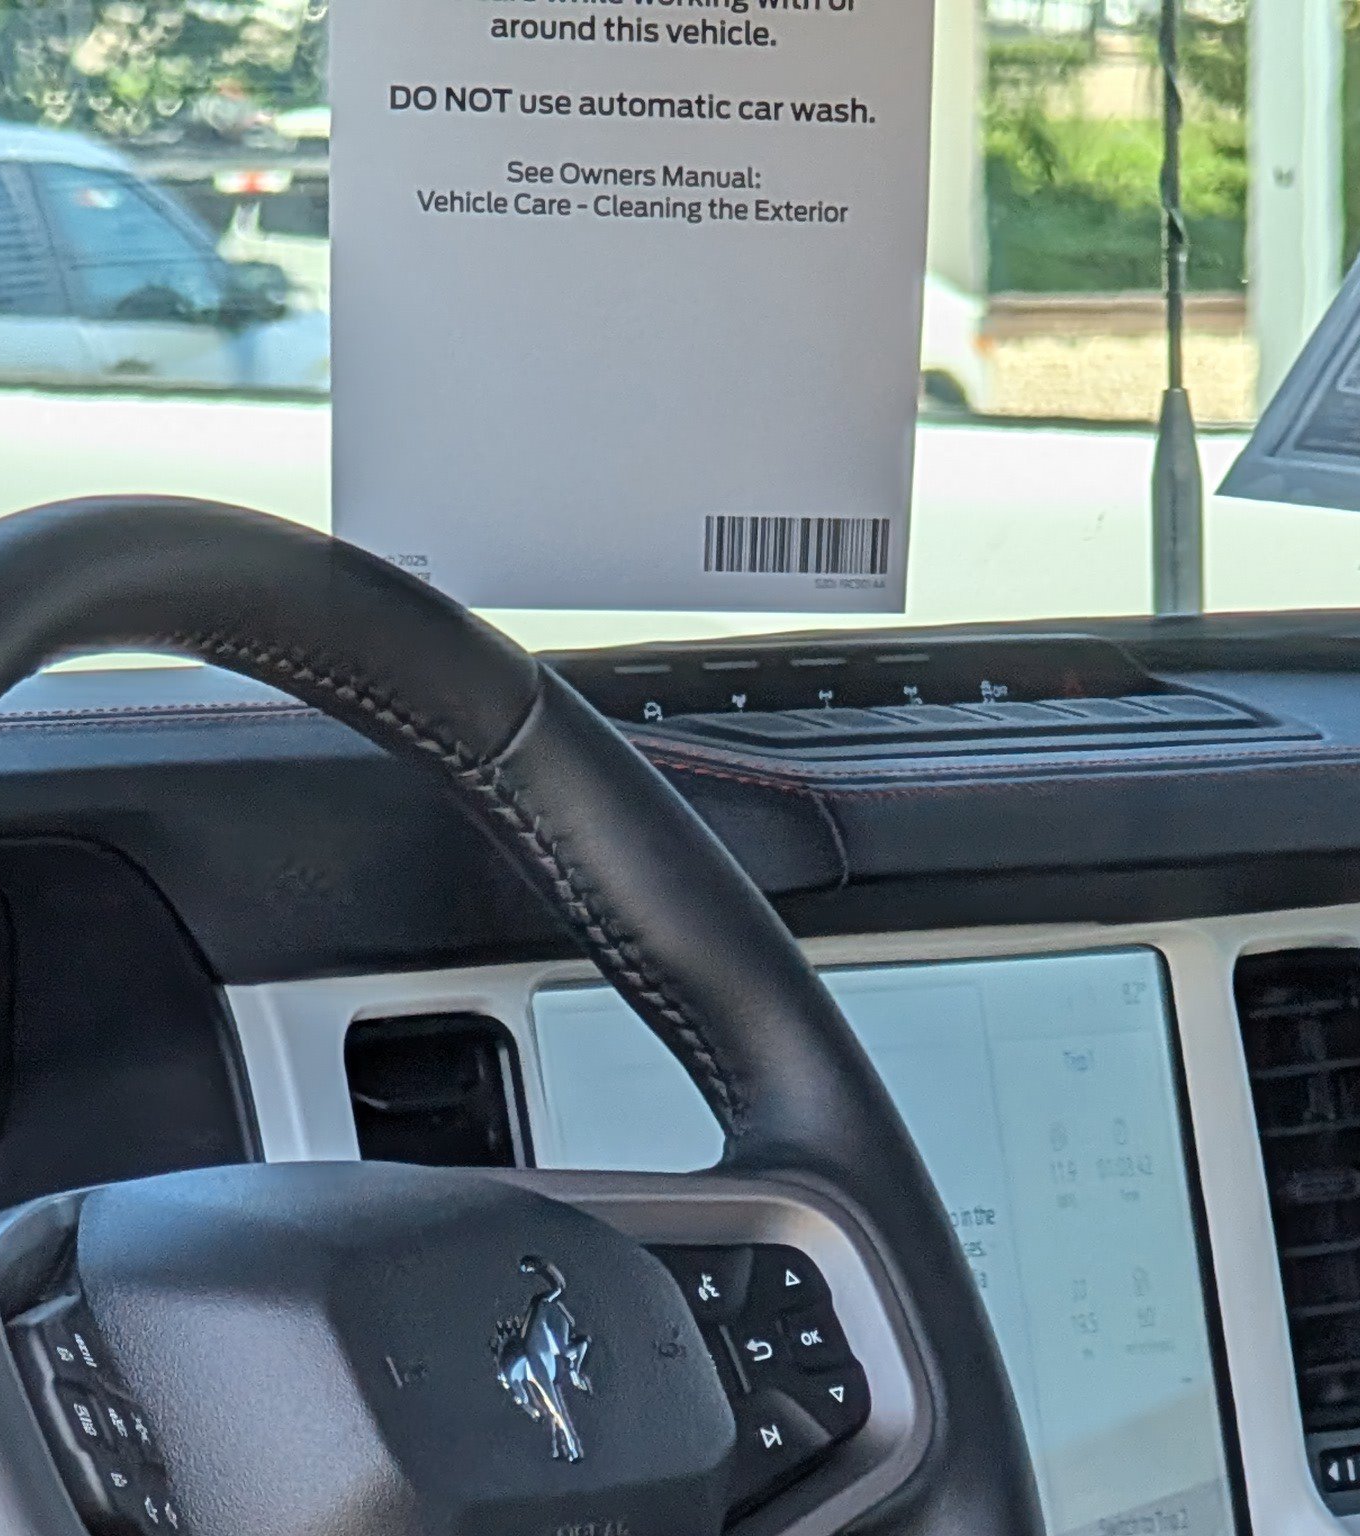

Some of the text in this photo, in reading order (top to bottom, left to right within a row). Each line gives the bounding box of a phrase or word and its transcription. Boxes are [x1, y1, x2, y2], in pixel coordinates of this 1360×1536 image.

[490, 15, 777, 47] around this vehicle.
[389, 85, 877, 125] DO NOT use automatic car wash.
[506, 160, 763, 190] See Owners Manual:
[416, 189, 509, 216] Vehicle
[512, 192, 572, 217] Care
[593, 194, 703, 224] Cleaning
[707, 197, 749, 221] the
[754, 199, 849, 224] Exterior
[800, 1329, 823, 1346] OK
